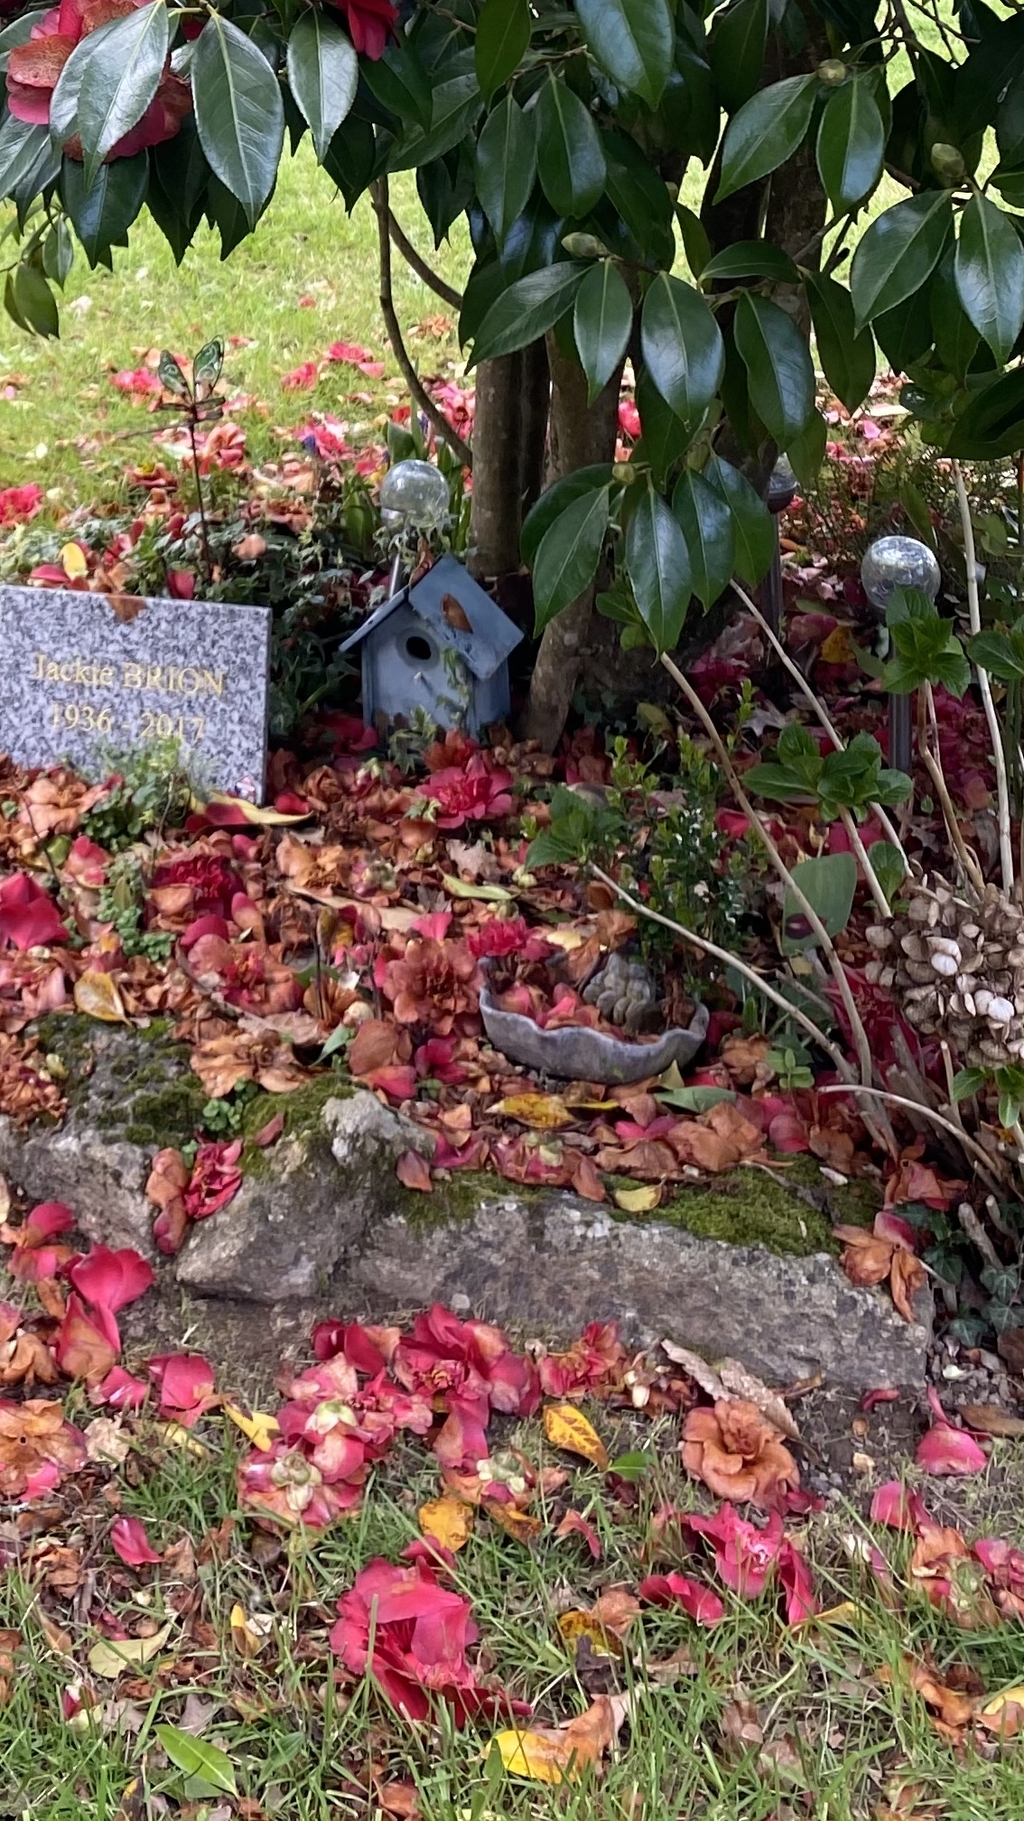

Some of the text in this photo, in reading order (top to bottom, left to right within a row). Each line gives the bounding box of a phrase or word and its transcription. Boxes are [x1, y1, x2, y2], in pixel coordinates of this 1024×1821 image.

[33, 654, 228, 696] Jackie BRION
[51, 702, 112, 734] 1936
[139, 712, 206, 745] 2017
